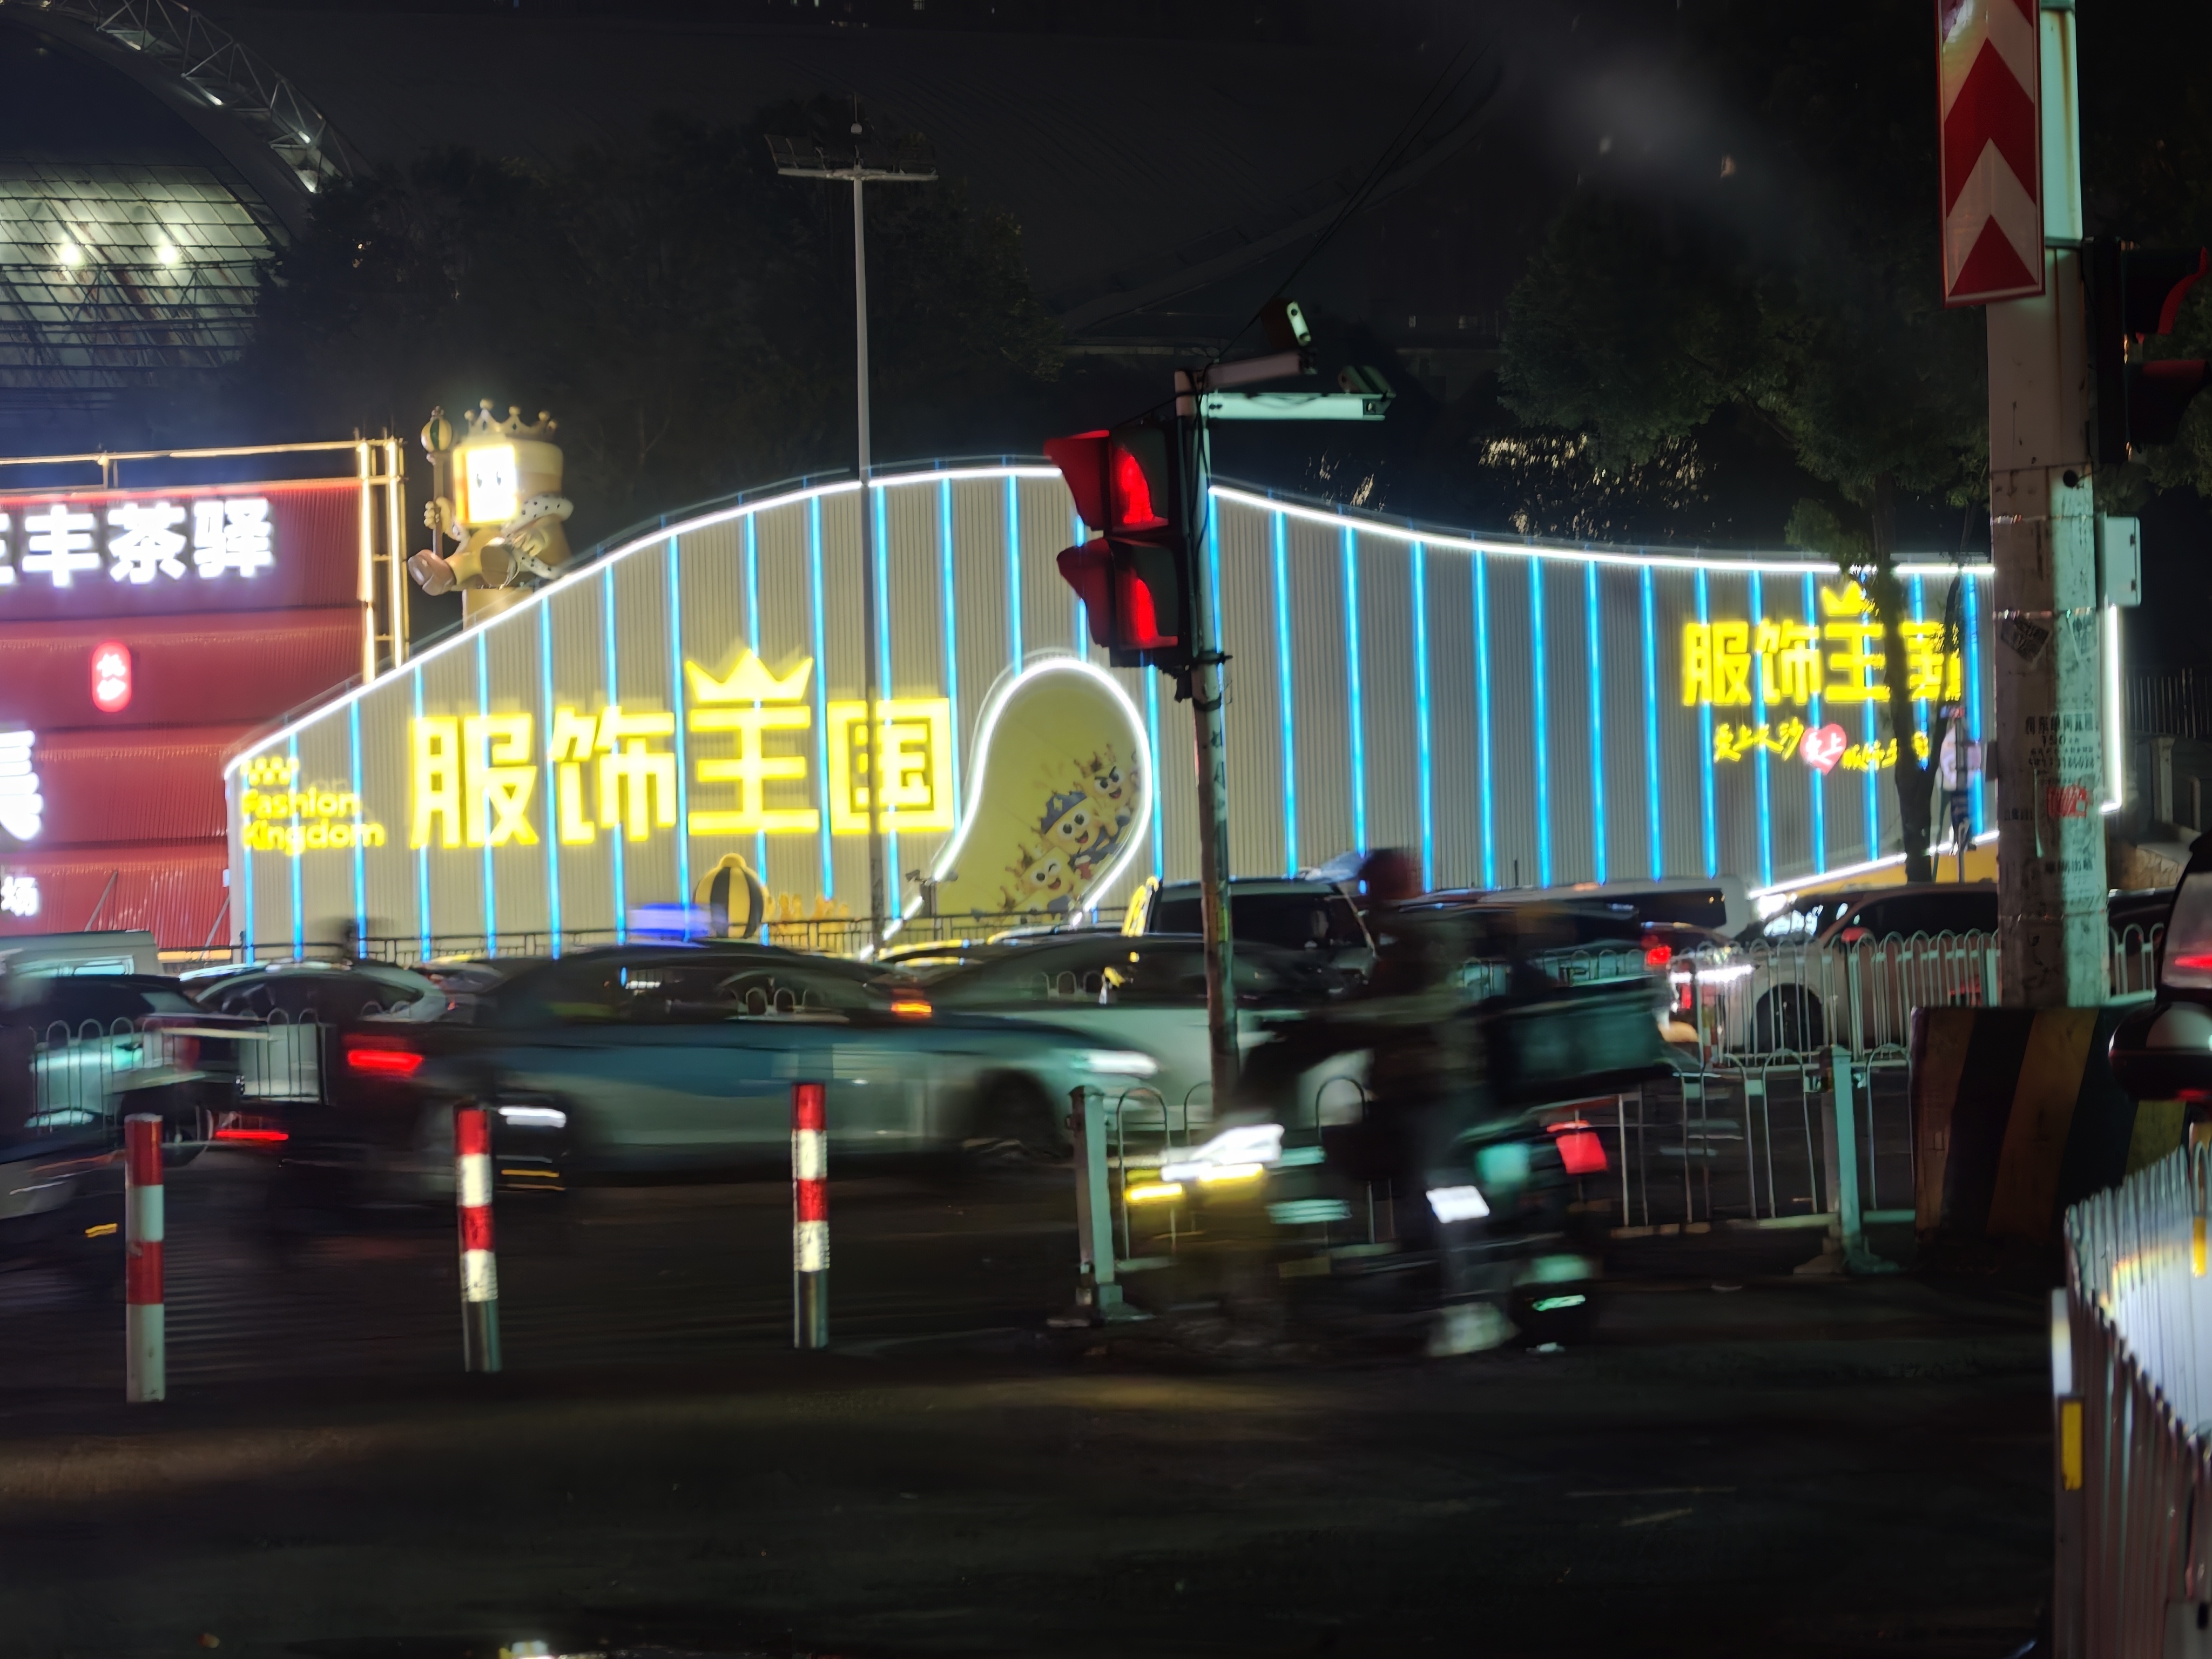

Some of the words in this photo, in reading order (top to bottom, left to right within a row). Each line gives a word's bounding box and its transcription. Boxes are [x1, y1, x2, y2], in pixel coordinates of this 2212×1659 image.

[0, 496, 273, 588] 丰茶驿
[242, 787, 360, 819] Fashion
[409, 697, 956, 850] 服饰王国
[242, 818, 386, 856] Kingdom
